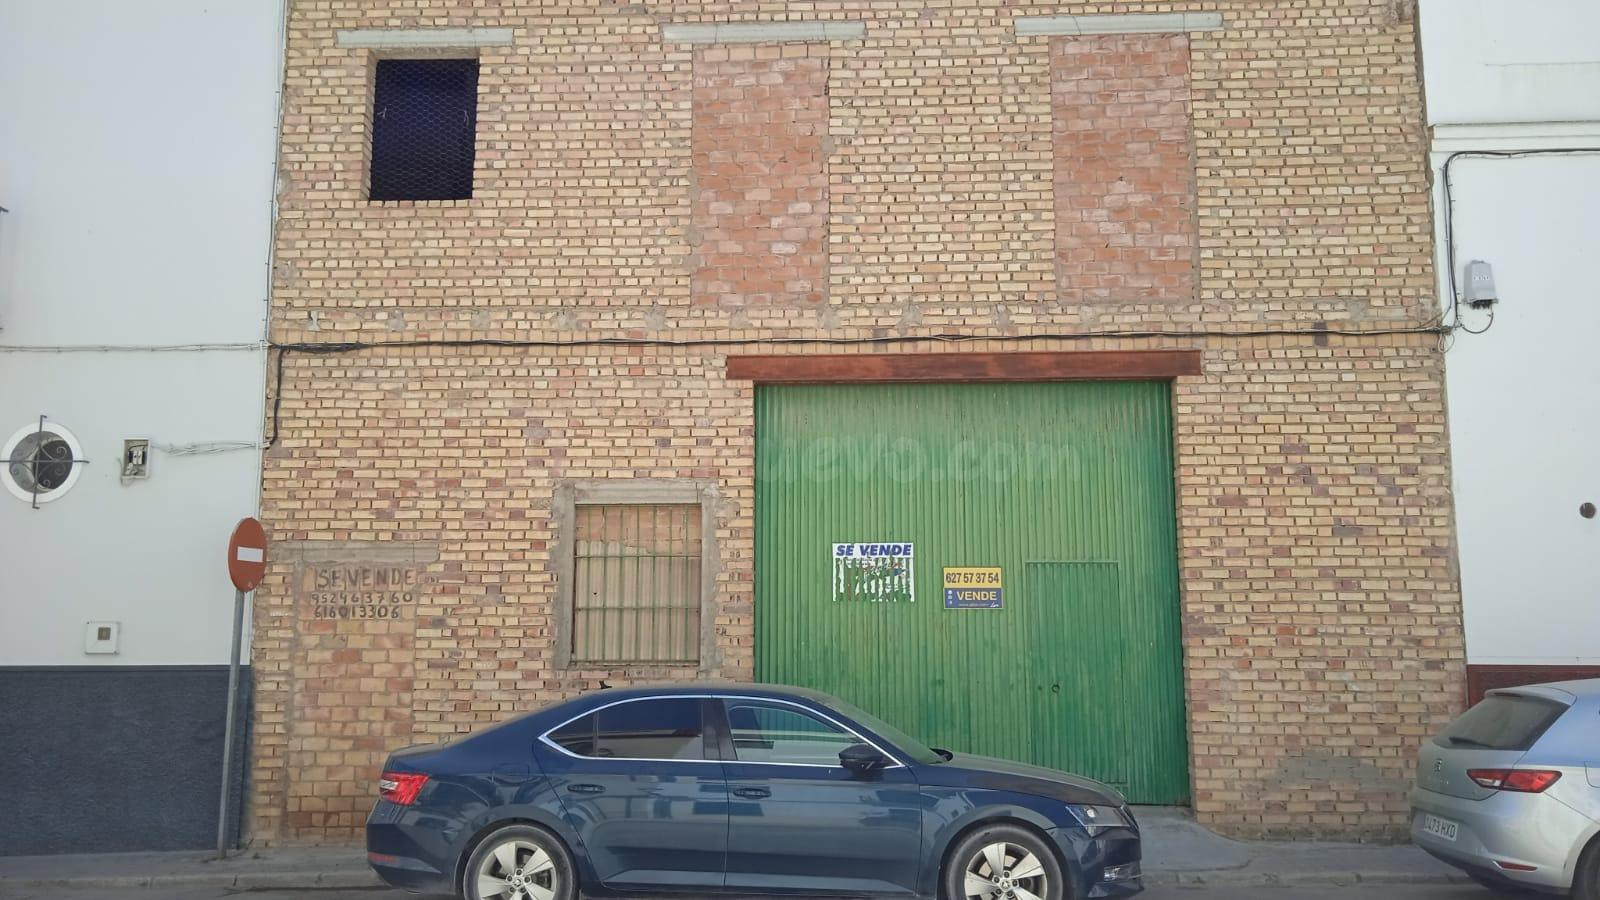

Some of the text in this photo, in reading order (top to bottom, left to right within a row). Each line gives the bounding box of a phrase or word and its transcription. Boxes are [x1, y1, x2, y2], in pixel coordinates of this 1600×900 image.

[836, 544, 912, 556] SE VENDE
[945, 572, 999, 583] 627 57 37 54
[956, 591, 998, 601] VENDE
